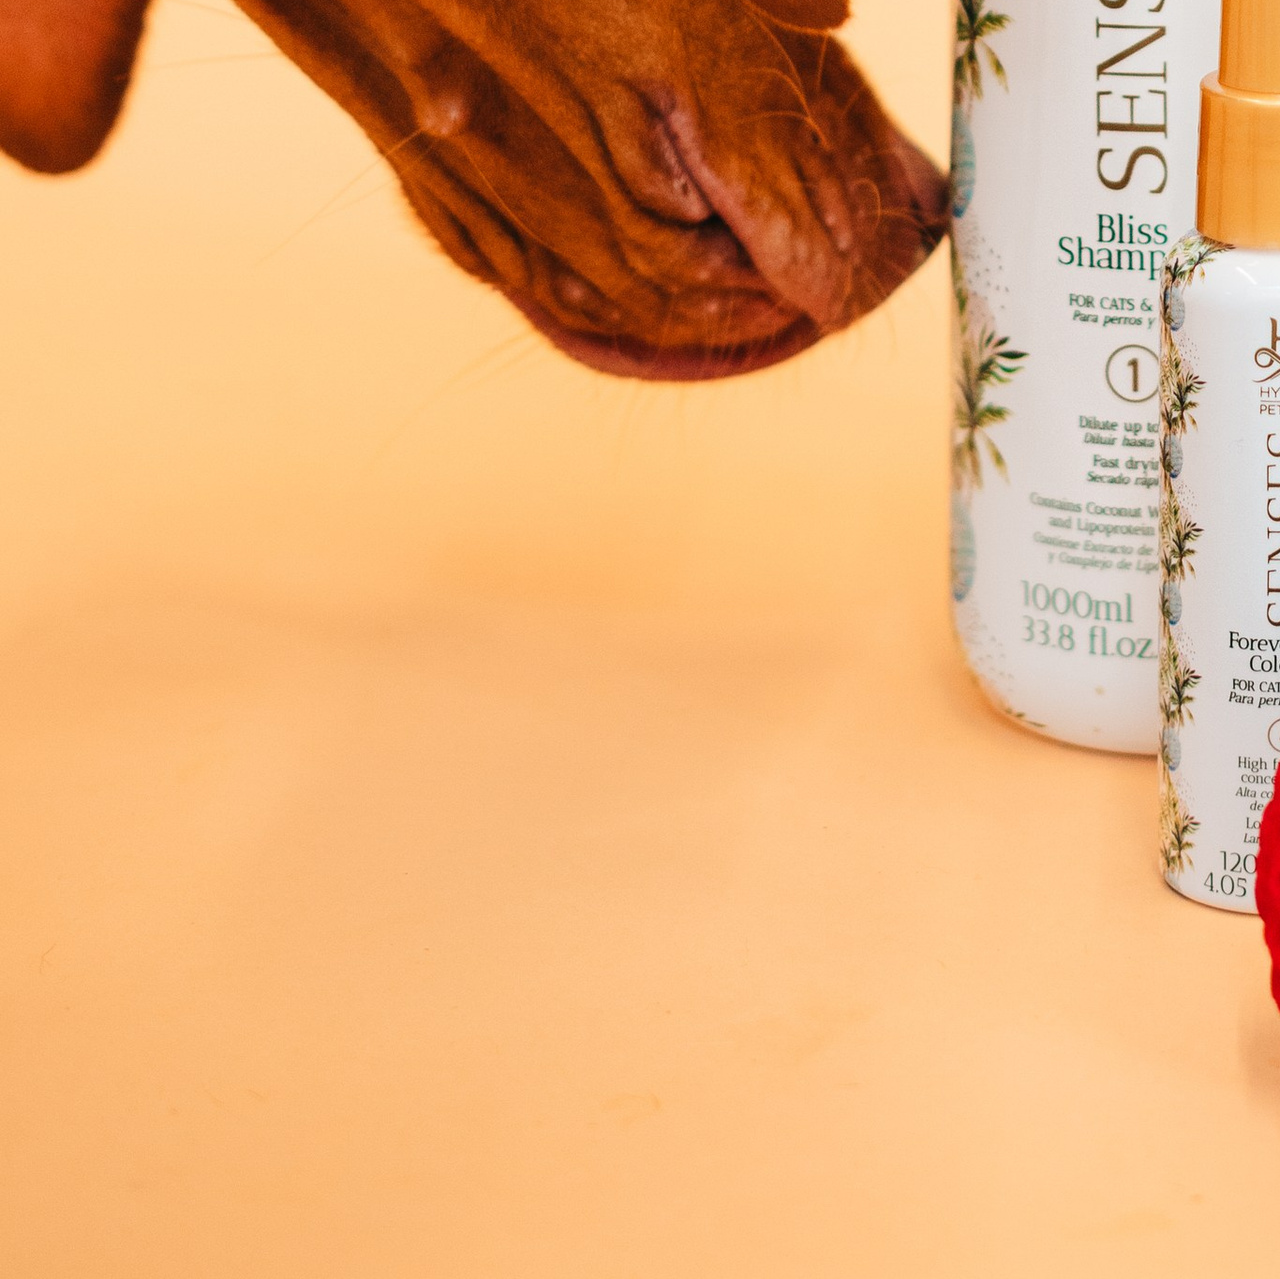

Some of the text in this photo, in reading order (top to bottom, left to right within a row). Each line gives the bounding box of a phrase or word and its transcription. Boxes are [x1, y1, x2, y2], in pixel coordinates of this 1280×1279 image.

[1096, 213, 1169, 246] Bliss
[1057, 235, 1166, 281] Shamp
[1069, 293, 1154, 312] FOR CATS &
[1072, 309, 1099, 323] Para
[1102, 314, 1143, 327] perros
[1126, 356, 1140, 393] 1
[1123, 422, 1143, 436] up
[1093, 454, 1120, 469] Fast
[1085, 501, 1142, 518] Coconut
[1020, 579, 1134, 623] 1000ml
[1021, 614, 1076, 652] 33.8
[1232, 678, 1256, 692] FOR
[1228, 690, 1254, 705] Para
[1237, 755, 1268, 773] High
[1235, 786, 1257, 799] Alta
[1249, 800, 1264, 812] de
[1219, 850, 1257, 876] 120
[1203, 871, 1248, 898] 4.05
